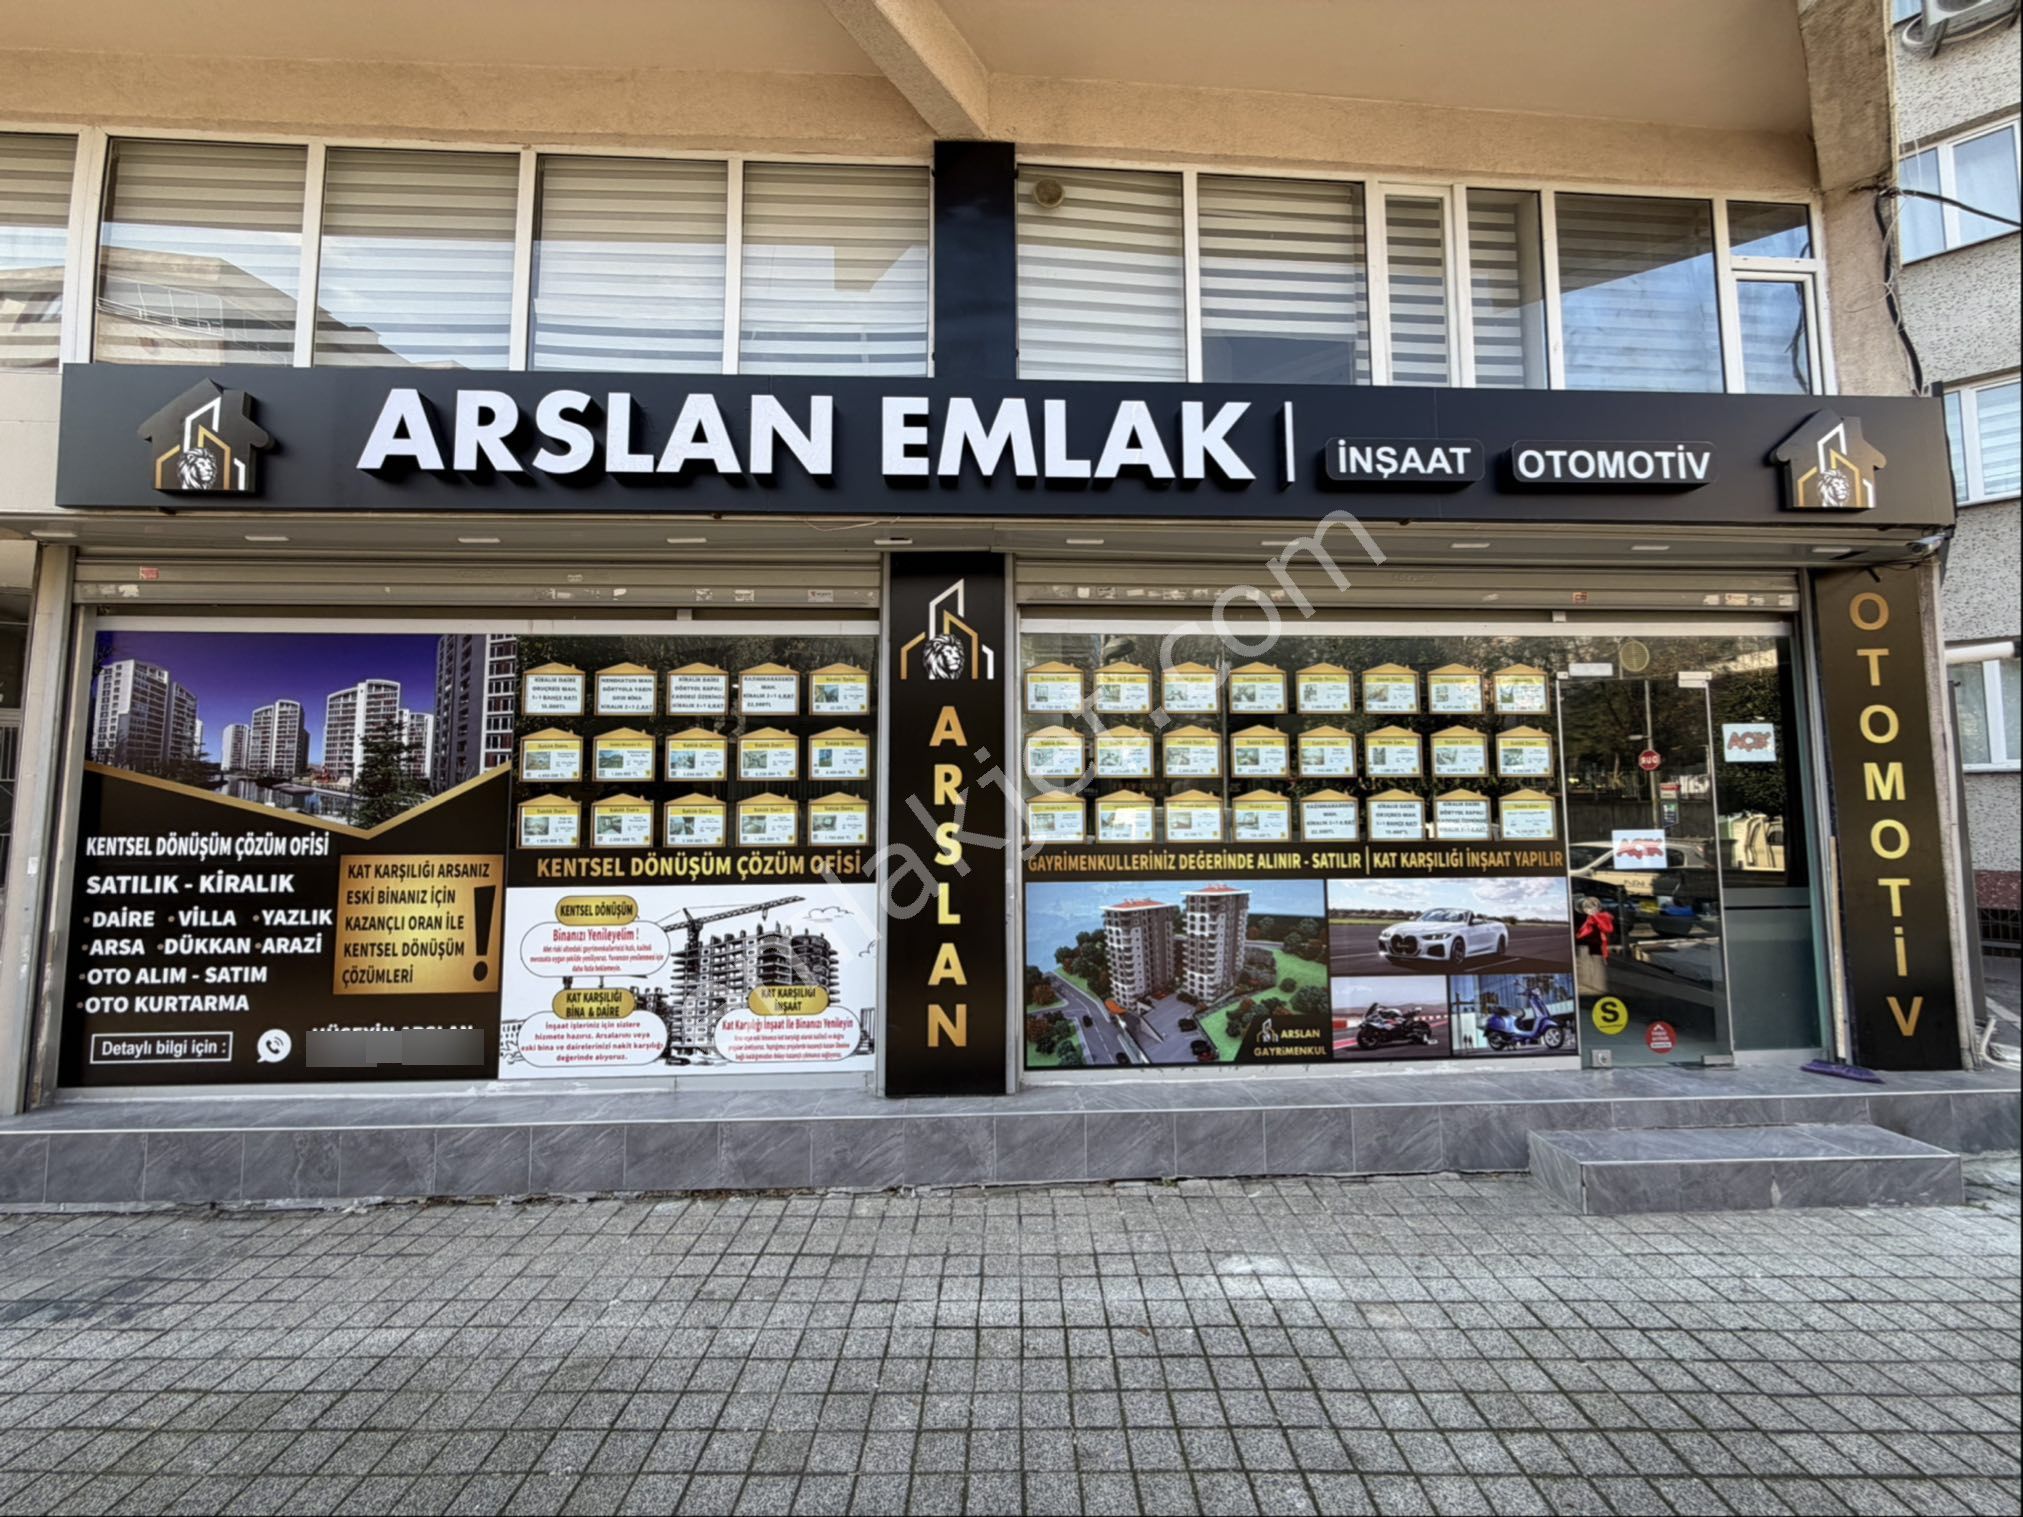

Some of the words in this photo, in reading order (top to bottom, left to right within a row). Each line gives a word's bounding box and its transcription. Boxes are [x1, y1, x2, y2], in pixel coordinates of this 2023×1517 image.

[356, 386, 833, 476] ARSLAN
[882, 395, 1258, 481] EMLAK
[1337, 438, 1472, 480] İNŞAAT
[1517, 443, 1711, 481] OTOMOTİV
[1848, 592, 1923, 1036] OTOMOTİV
[86, 836, 153, 857] KENTSEL
[155, 832, 232, 862] DÖNÜŞÜM
[235, 832, 287, 862] ÇÖZÜM
[289, 831, 330, 857] OFİSİ
[348, 864, 372, 879] KAT
[374, 860, 434, 883] KARŞILIĞI
[437, 863, 490, 878] ARSANIZ
[537, 857, 625, 878] KENTSEL
[630, 852, 732, 882] DÖNÜŞÜM
[736, 851, 804, 882] ÇÖZÜM
[809, 850, 862, 877] OFİSİ
[1028, 850, 1175, 872] GAYRİMENKULLERİNİZ
[1179, 848, 1253, 870] DEĞERİNDE
[1257, 853, 1301, 870] ALINIR
[1312, 852, 1362, 869] SATILIR
[1374, 852, 1397, 868] KAT
[1400, 848, 1464, 872] KARŞILIĞI
[1466, 848, 1512, 872] İNŞAAT
[1514, 852, 1563, 868] YAPILIR
[86, 874, 180, 895] SATILIK
[199, 869, 296, 894] KİRALIK
[927, 705, 968, 1048] ARSLAN
[346, 886, 374, 905] ESKİ
[378, 886, 428, 904] BİNANIZ
[430, 885, 456, 908] İÇİN
[92, 906, 156, 928] DAİRE
[178, 905, 238, 927] VİLLA
[261, 909, 333, 926] YAZLIK
[560, 904, 594, 917] KENTSEL
[594, 901, 634, 920] DÖNÜŞÜM
[345, 916, 405, 935] KAZANÇLI
[408, 916, 442, 930] ORAN
[445, 912, 464, 930] İLE
[472, 885, 496, 982] !
[552, 928, 586, 942] Binanızı
[89, 939, 146, 956] ARSA
[164, 934, 252, 955] DÜKKAN
[261, 932, 323, 954] ARAZİ
[344, 942, 398, 958] KENTSEL
[402, 938, 465, 960] DÖNÜŞÜM
[86, 968, 132, 985] OTO
[135, 968, 187, 985] ALIM
[204, 966, 268, 984] SATIM
[342, 964, 414, 988] ÇÖZÜMLERİ
[85, 997, 130, 1014] OTO
[134, 995, 250, 1013] KURTARMA
[566, 992, 581, 1003] KAT
[761, 988, 776, 999] KAT
[774, 998, 802, 1012] İNŞAAT
[566, 1004, 584, 1018] BİNA
[588, 1007, 594, 1017] &
[596, 1004, 620, 1017] DAİRE
[1600, 1002, 1620, 1023] S
[534, 1032, 564, 1040] hizmete
[545, 1022, 569, 1032] İnşaat
[570, 1022, 600, 1030] işleriniz
[601, 1022, 614, 1030] için
[616, 1020, 640, 1028] sizlere
[1280, 1029, 1320, 1039] ARSLAN
[102, 1040, 152, 1058] Detaylı
[155, 1040, 188, 1058] bilgi
[190, 1040, 218, 1057] için
[556, 1054, 594, 1063] değerinde
